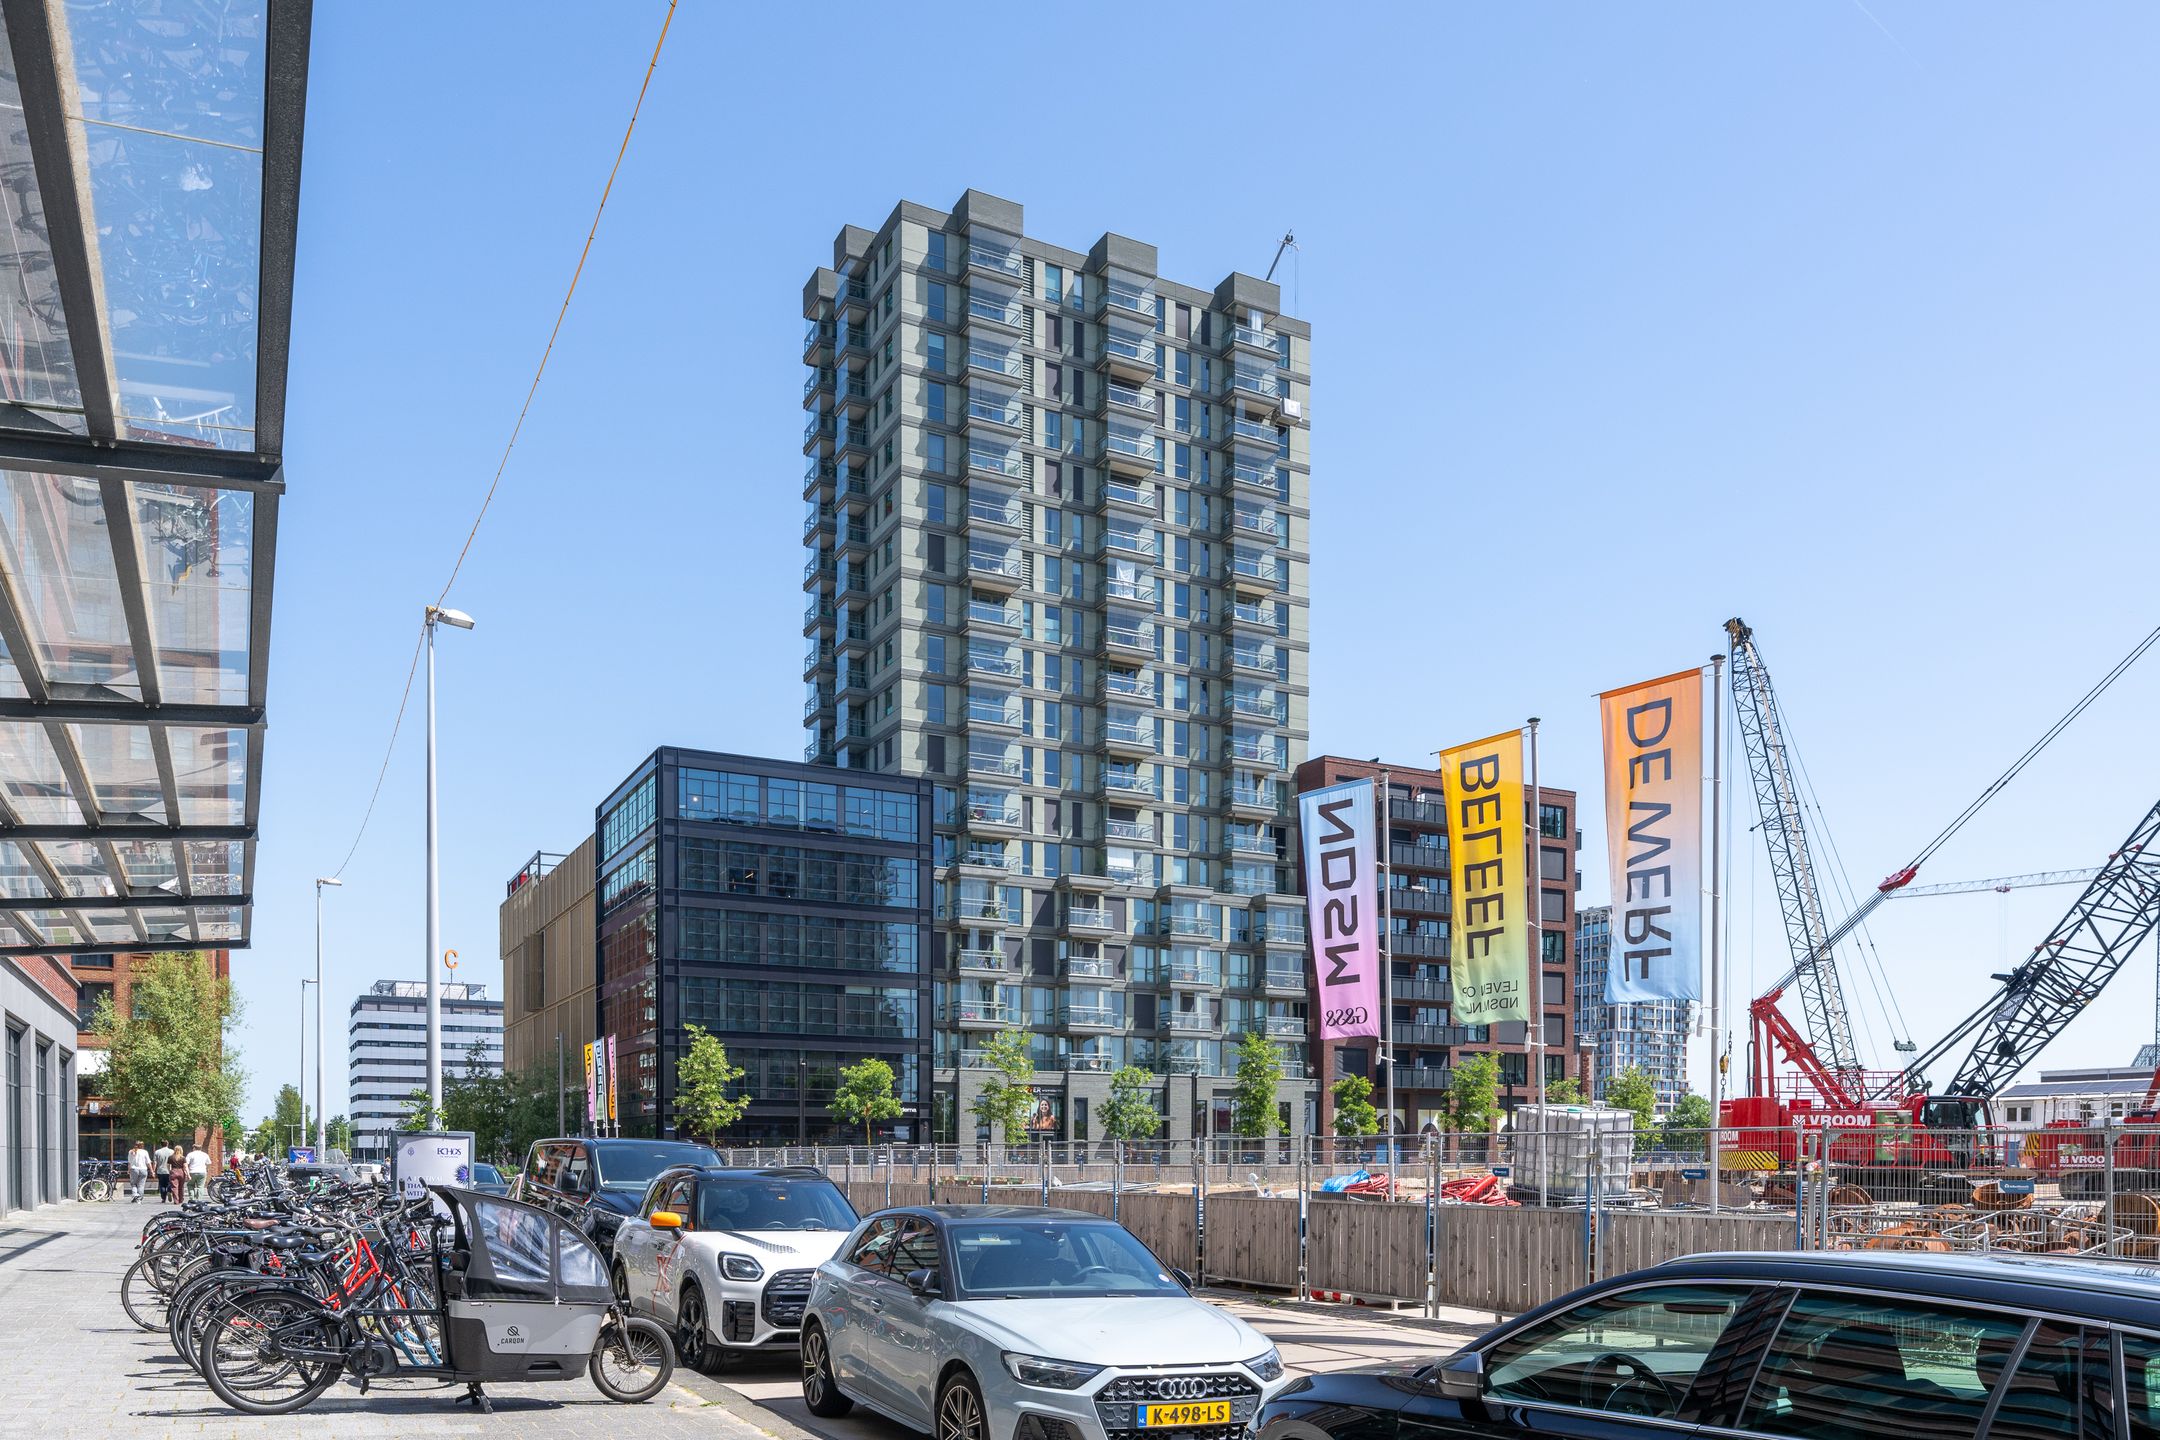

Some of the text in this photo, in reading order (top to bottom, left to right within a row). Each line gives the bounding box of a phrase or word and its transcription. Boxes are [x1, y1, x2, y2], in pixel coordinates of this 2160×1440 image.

[1809, 1114, 1871, 1126] VROOM
[500, 1336, 525, 1345] CARQON
[1153, 1404, 1225, 1425] K-498-LS
